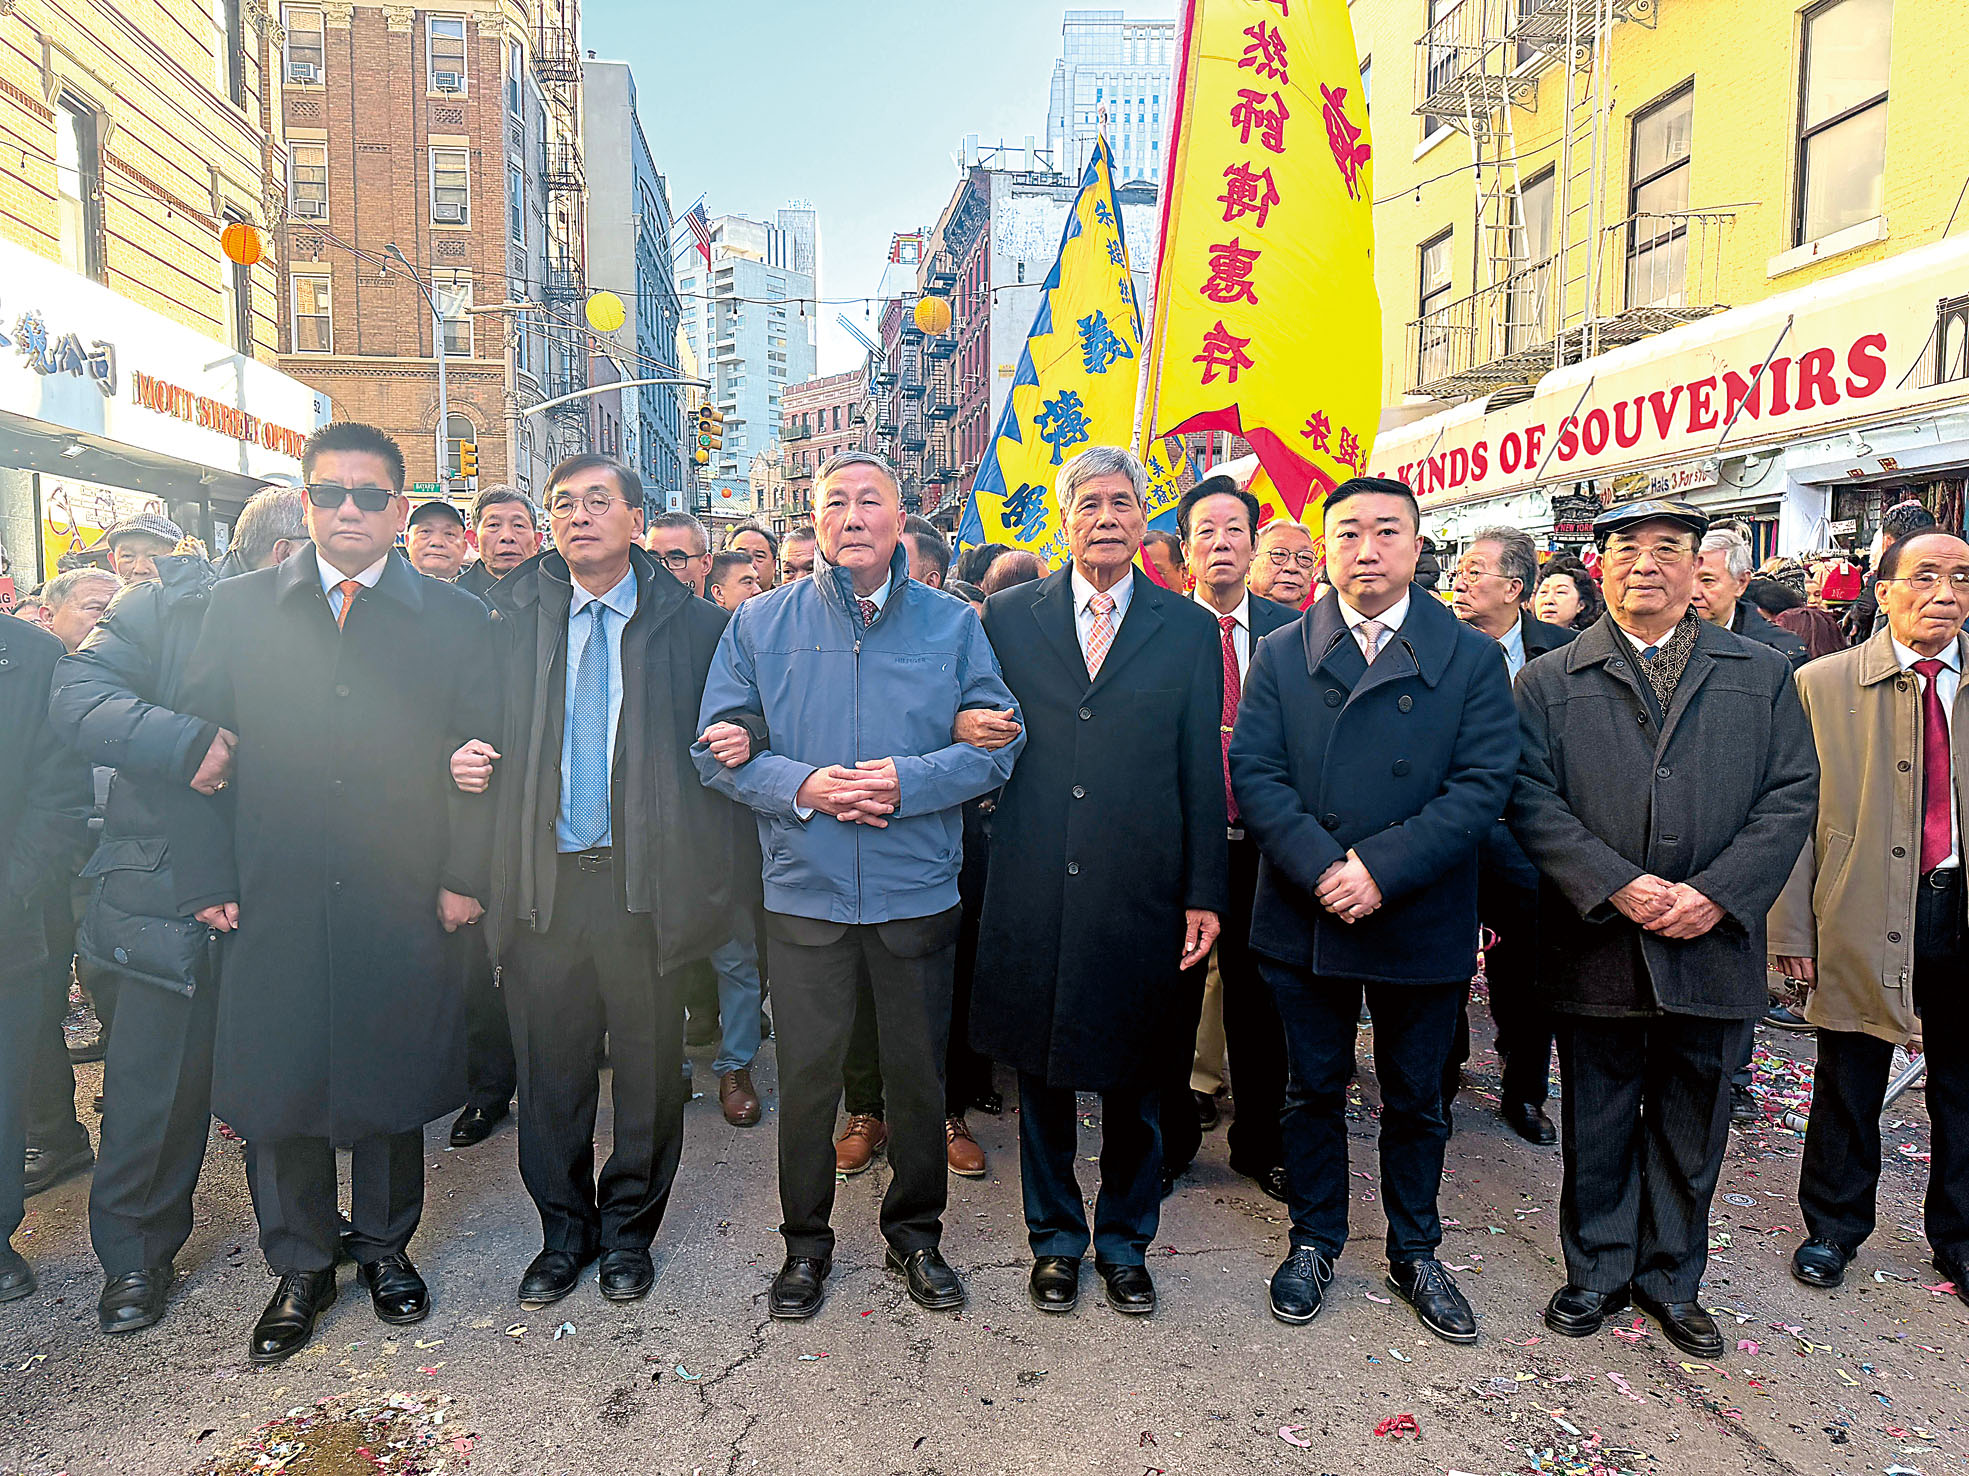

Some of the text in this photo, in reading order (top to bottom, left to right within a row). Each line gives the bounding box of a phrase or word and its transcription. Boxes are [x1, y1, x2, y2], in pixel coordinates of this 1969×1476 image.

[131, 370, 196, 422] MOTT
[196, 395, 262, 444] STREET
[313, 399, 321, 414] 52
[1397, 332, 1888, 497] KINDS OF SOUVENIRS
[1671, 472, 1678, 490] 3
[1678, 470, 1693, 487] For
[1560, 523, 1575, 532] NEW
